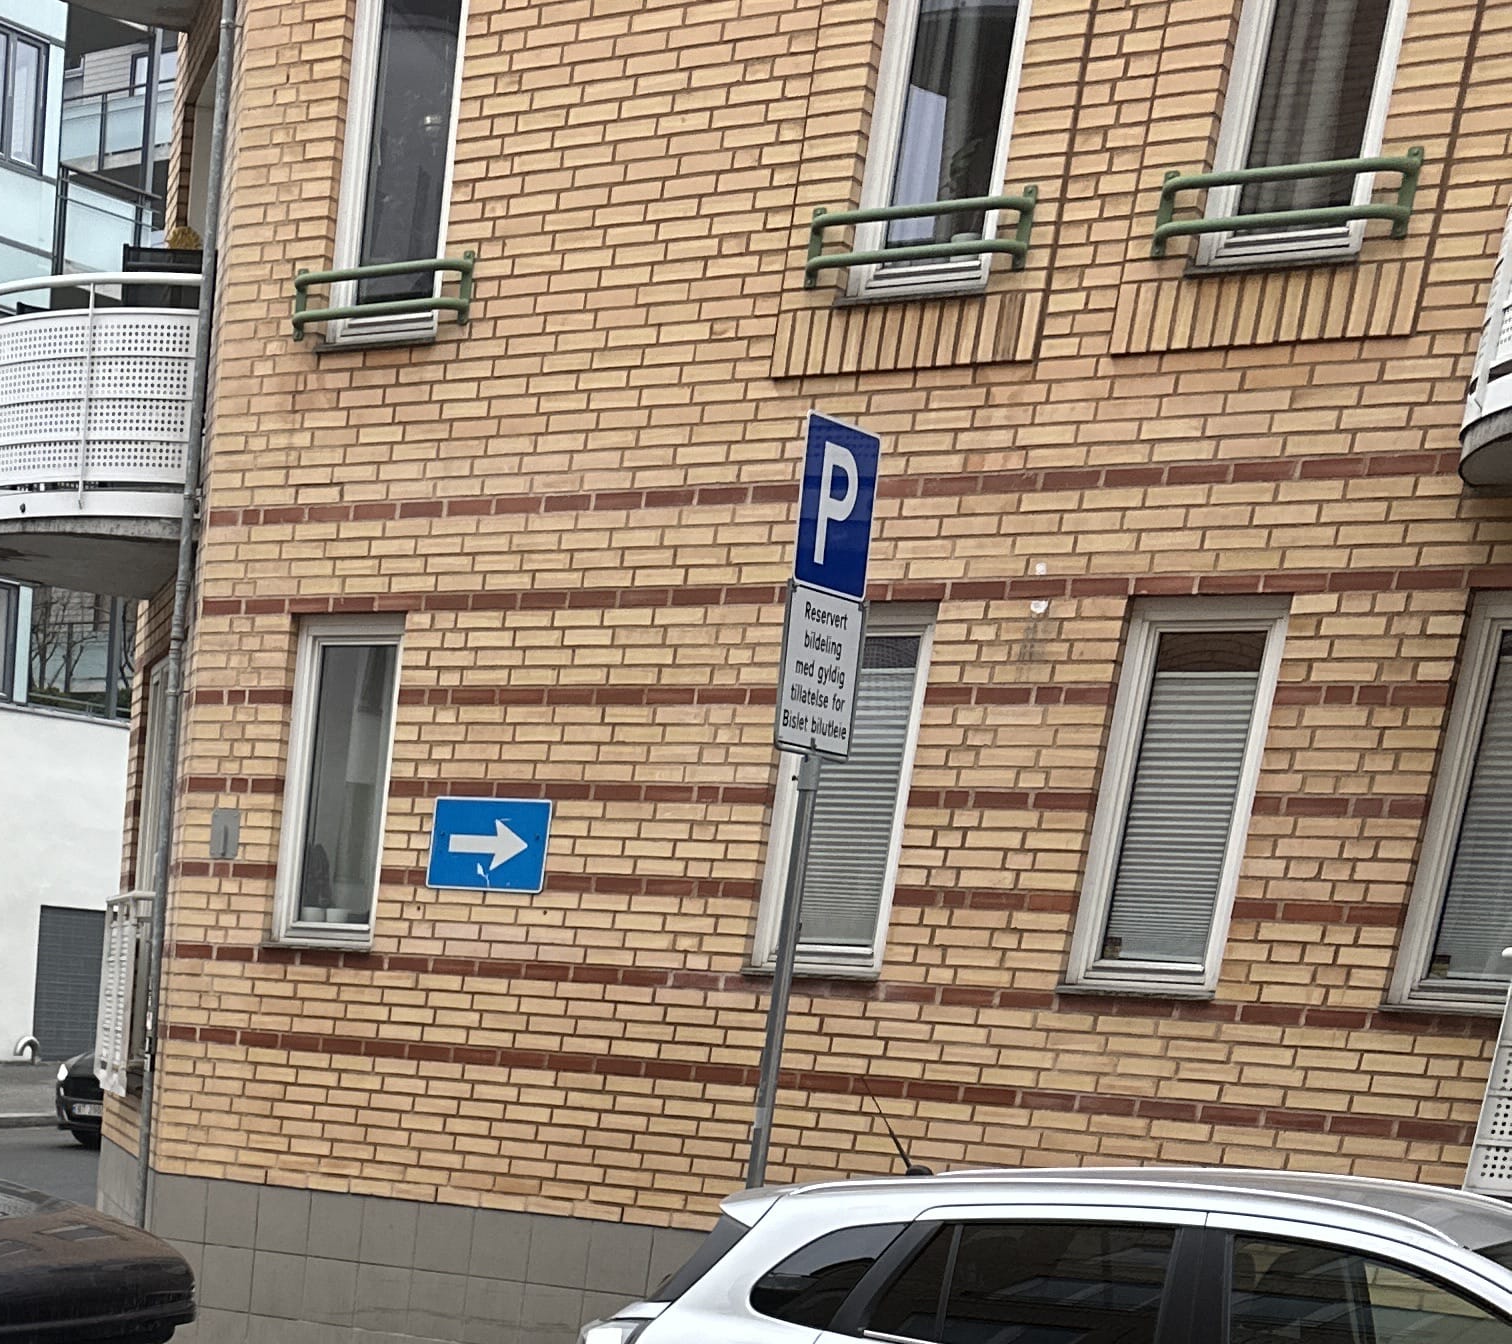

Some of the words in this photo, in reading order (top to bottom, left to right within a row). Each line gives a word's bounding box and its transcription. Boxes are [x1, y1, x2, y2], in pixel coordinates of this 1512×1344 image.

[813, 440, 859, 565] P
[804, 601, 848, 631] Reservert
[803, 629, 842, 661] bildeling
[795, 660, 815, 678] med
[817, 664, 845, 690] gyldig
[790, 684, 829, 709] tillatelse
[831, 693, 846, 713] for
[782, 709, 809, 733] Bislet
[810, 715, 847, 740] bilutleie
